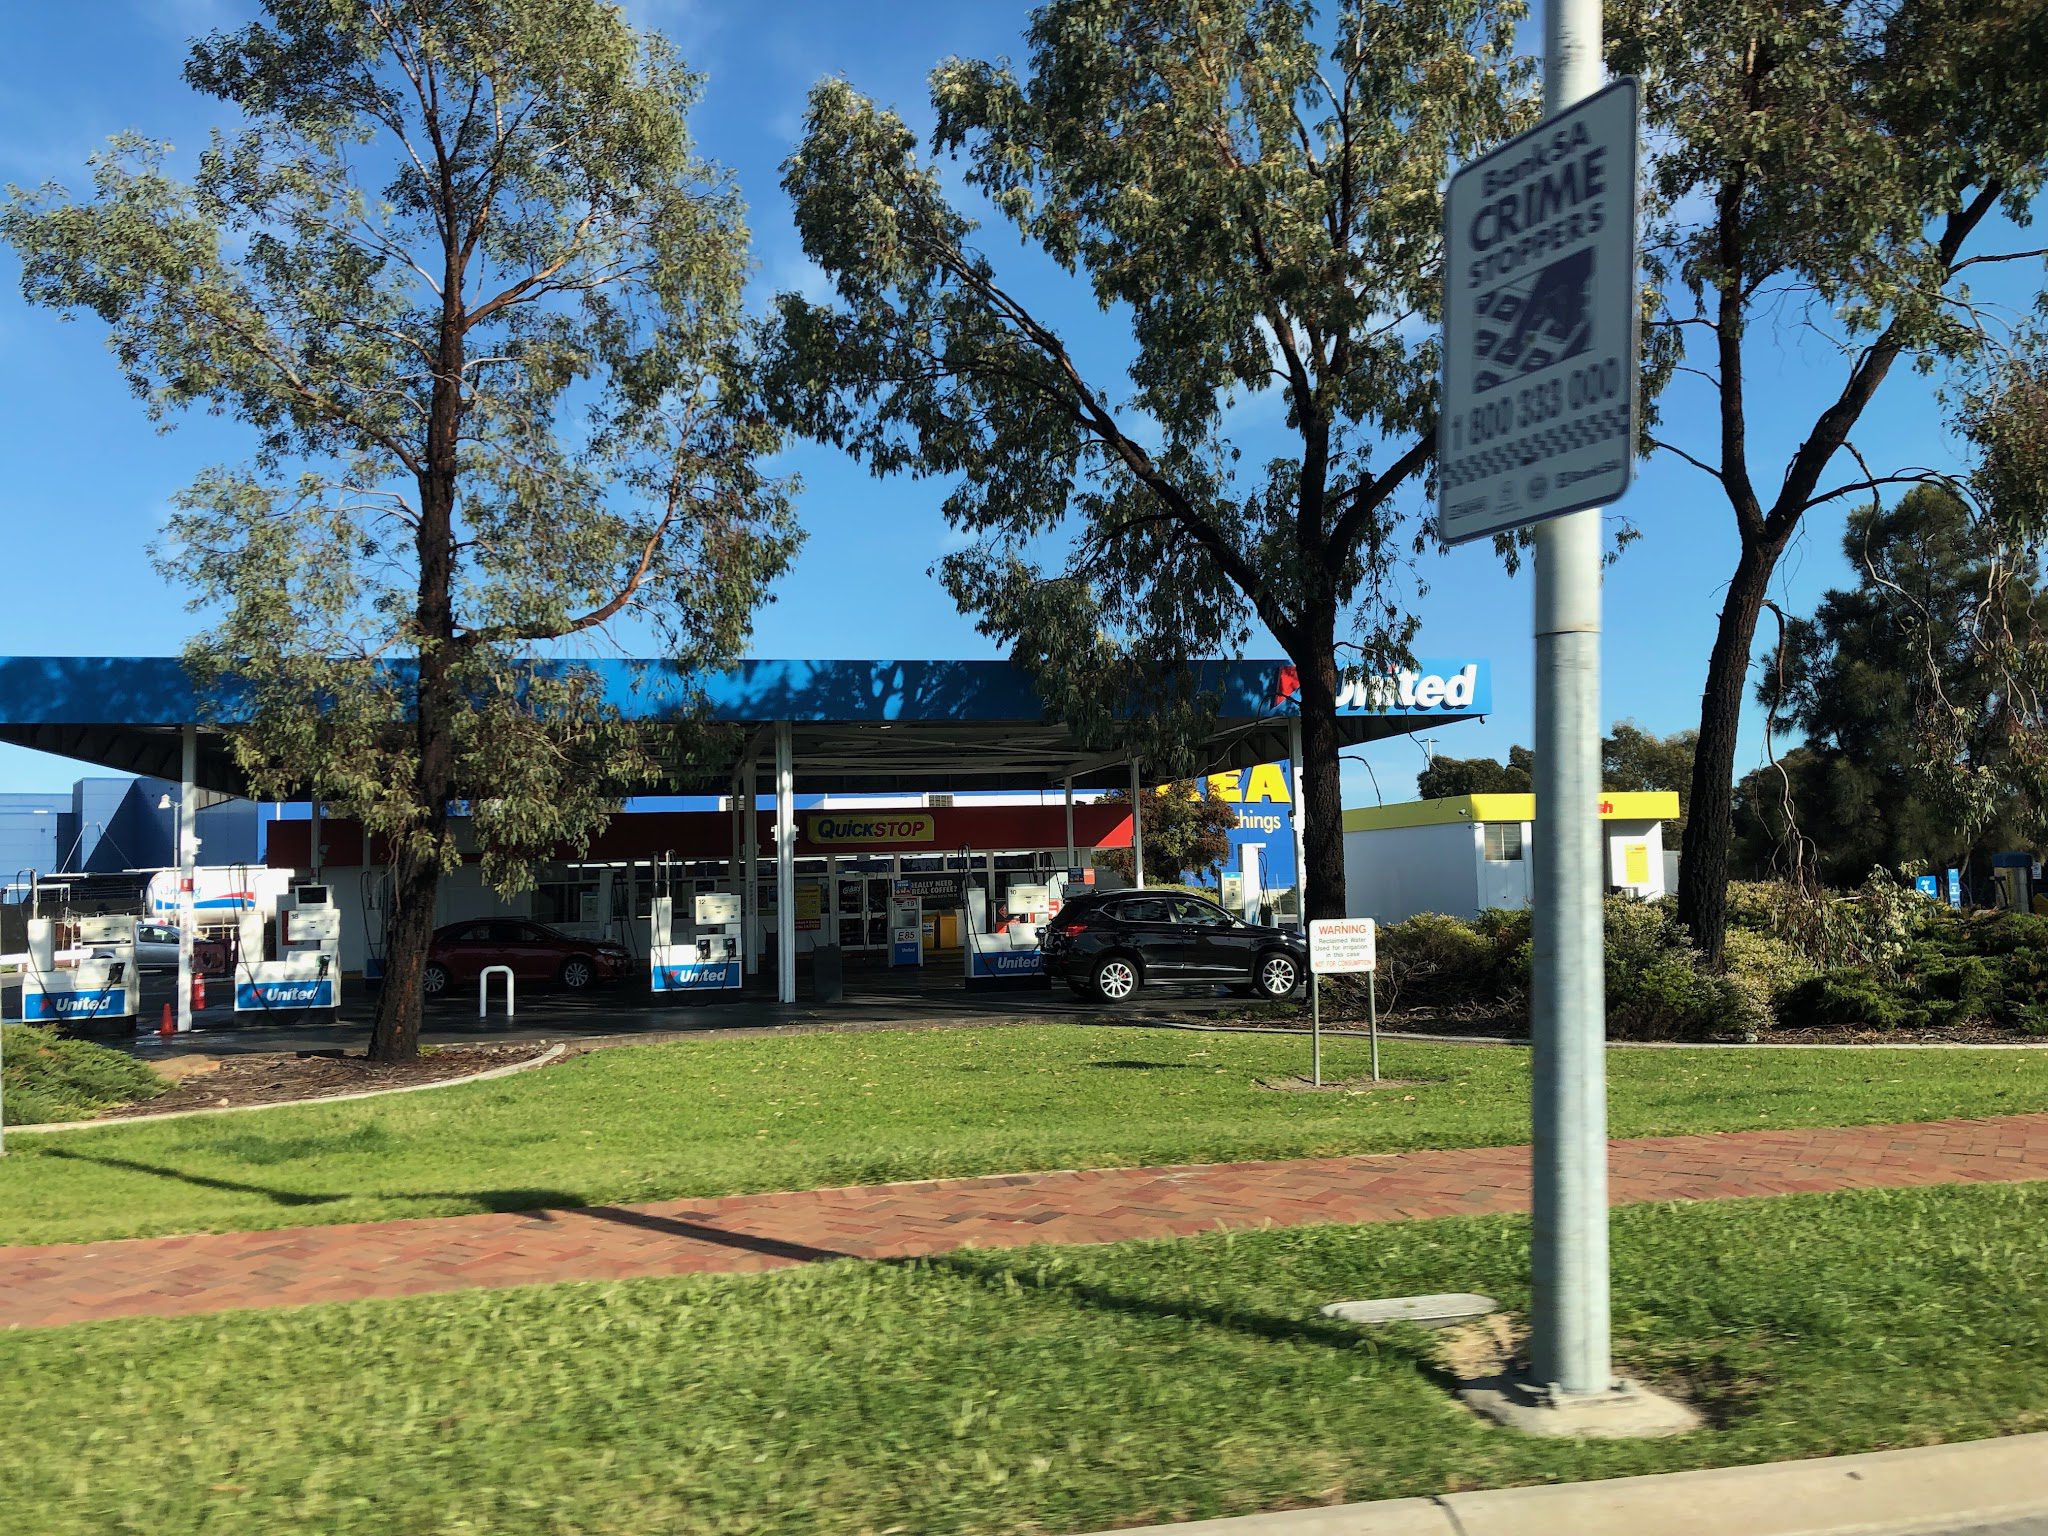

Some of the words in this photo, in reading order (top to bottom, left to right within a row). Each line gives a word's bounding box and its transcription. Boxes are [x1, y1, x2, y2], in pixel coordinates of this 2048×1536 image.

[1482, 120, 1590, 198] BankSA
[1471, 145, 1607, 251] CRIME
[1469, 202, 1605, 289] STOPPERS
[1451, 414, 1464, 452] 1
[1469, 396, 1513, 445] 800
[1518, 377, 1563, 428] 333
[1568, 357, 1620, 411] 000
[931, 886, 958, 894] COFFEE?
[898, 931, 915, 940] E85
[1319, 924, 1367, 934] WARNING
[997, 956, 1040, 969] United
[266, 986, 319, 1002] United
[56, 995, 111, 1012] United
